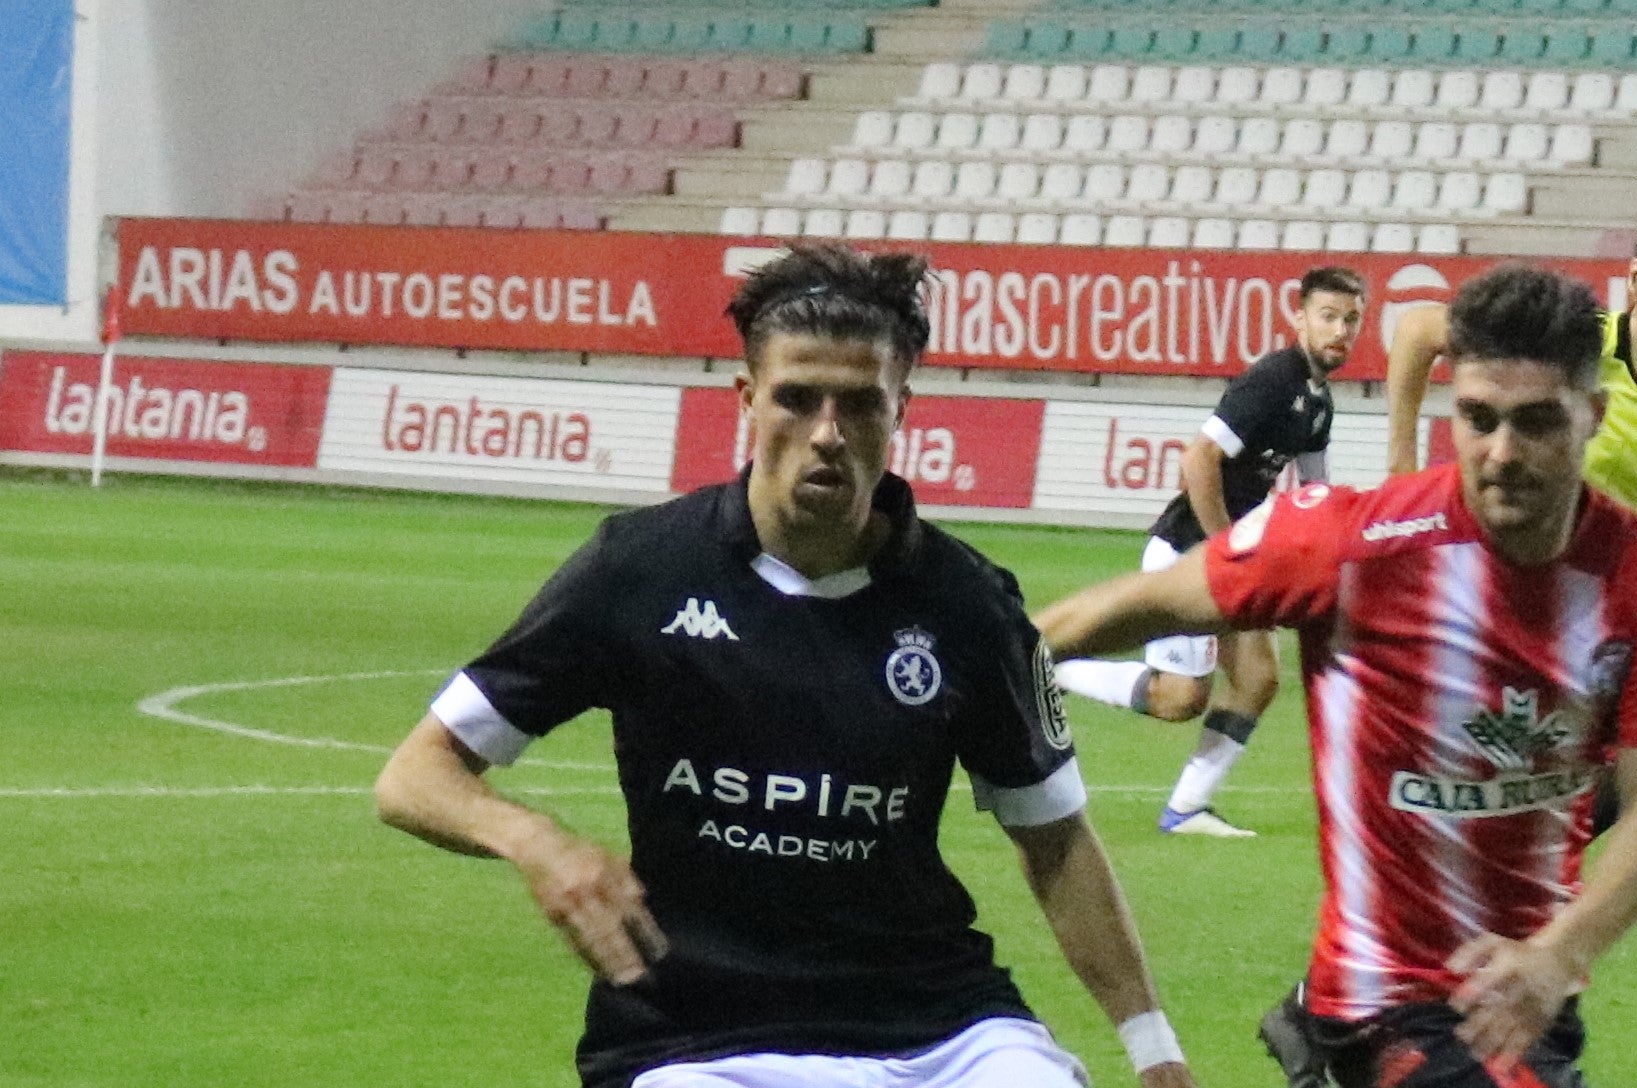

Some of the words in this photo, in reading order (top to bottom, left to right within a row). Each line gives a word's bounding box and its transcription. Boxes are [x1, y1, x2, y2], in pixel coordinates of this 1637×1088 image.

[128, 246, 299, 315] ARIAS
[309, 270, 657, 326] AUTOESCUELA
[44, 365, 250, 444] lantania
[381, 385, 590, 463] lantania
[662, 757, 910, 826] ASPIRE
[698, 819, 878, 862] ACADEMY
